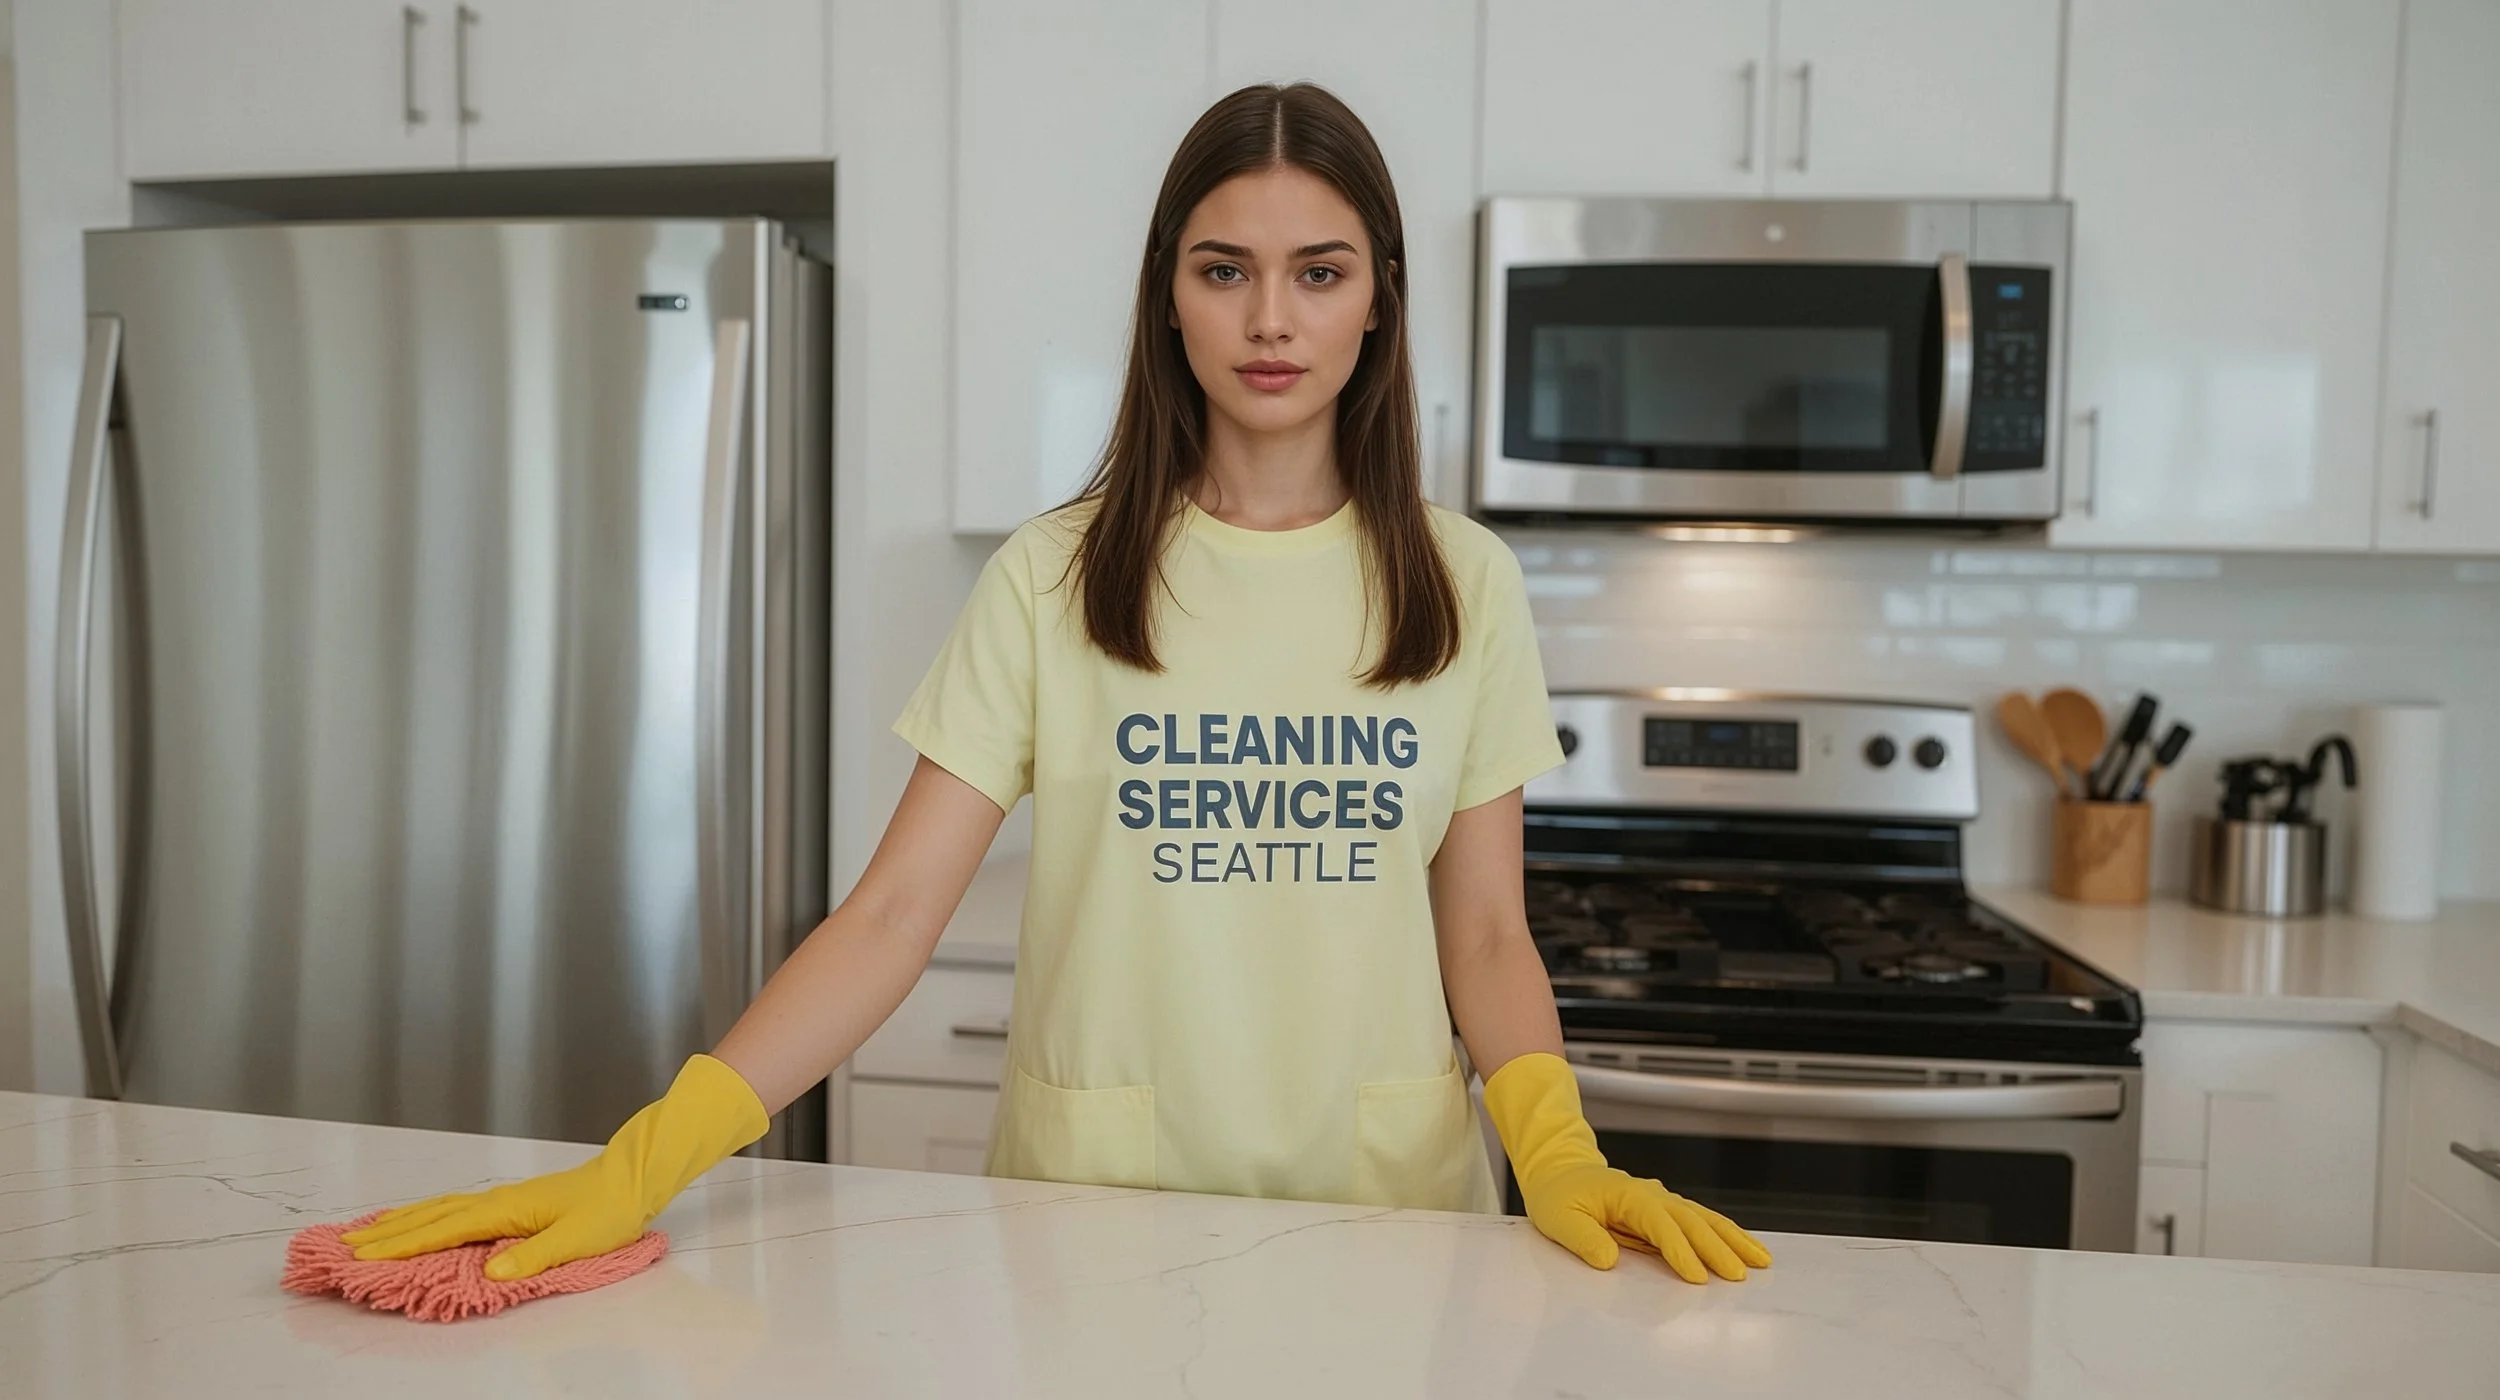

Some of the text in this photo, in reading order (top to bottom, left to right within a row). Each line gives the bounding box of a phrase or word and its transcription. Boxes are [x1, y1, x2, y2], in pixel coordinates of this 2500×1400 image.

[1116, 713, 1419, 769] CLEANING
[1118, 779, 1404, 830] SERVICES
[1152, 842, 1378, 883] SEATTLE
